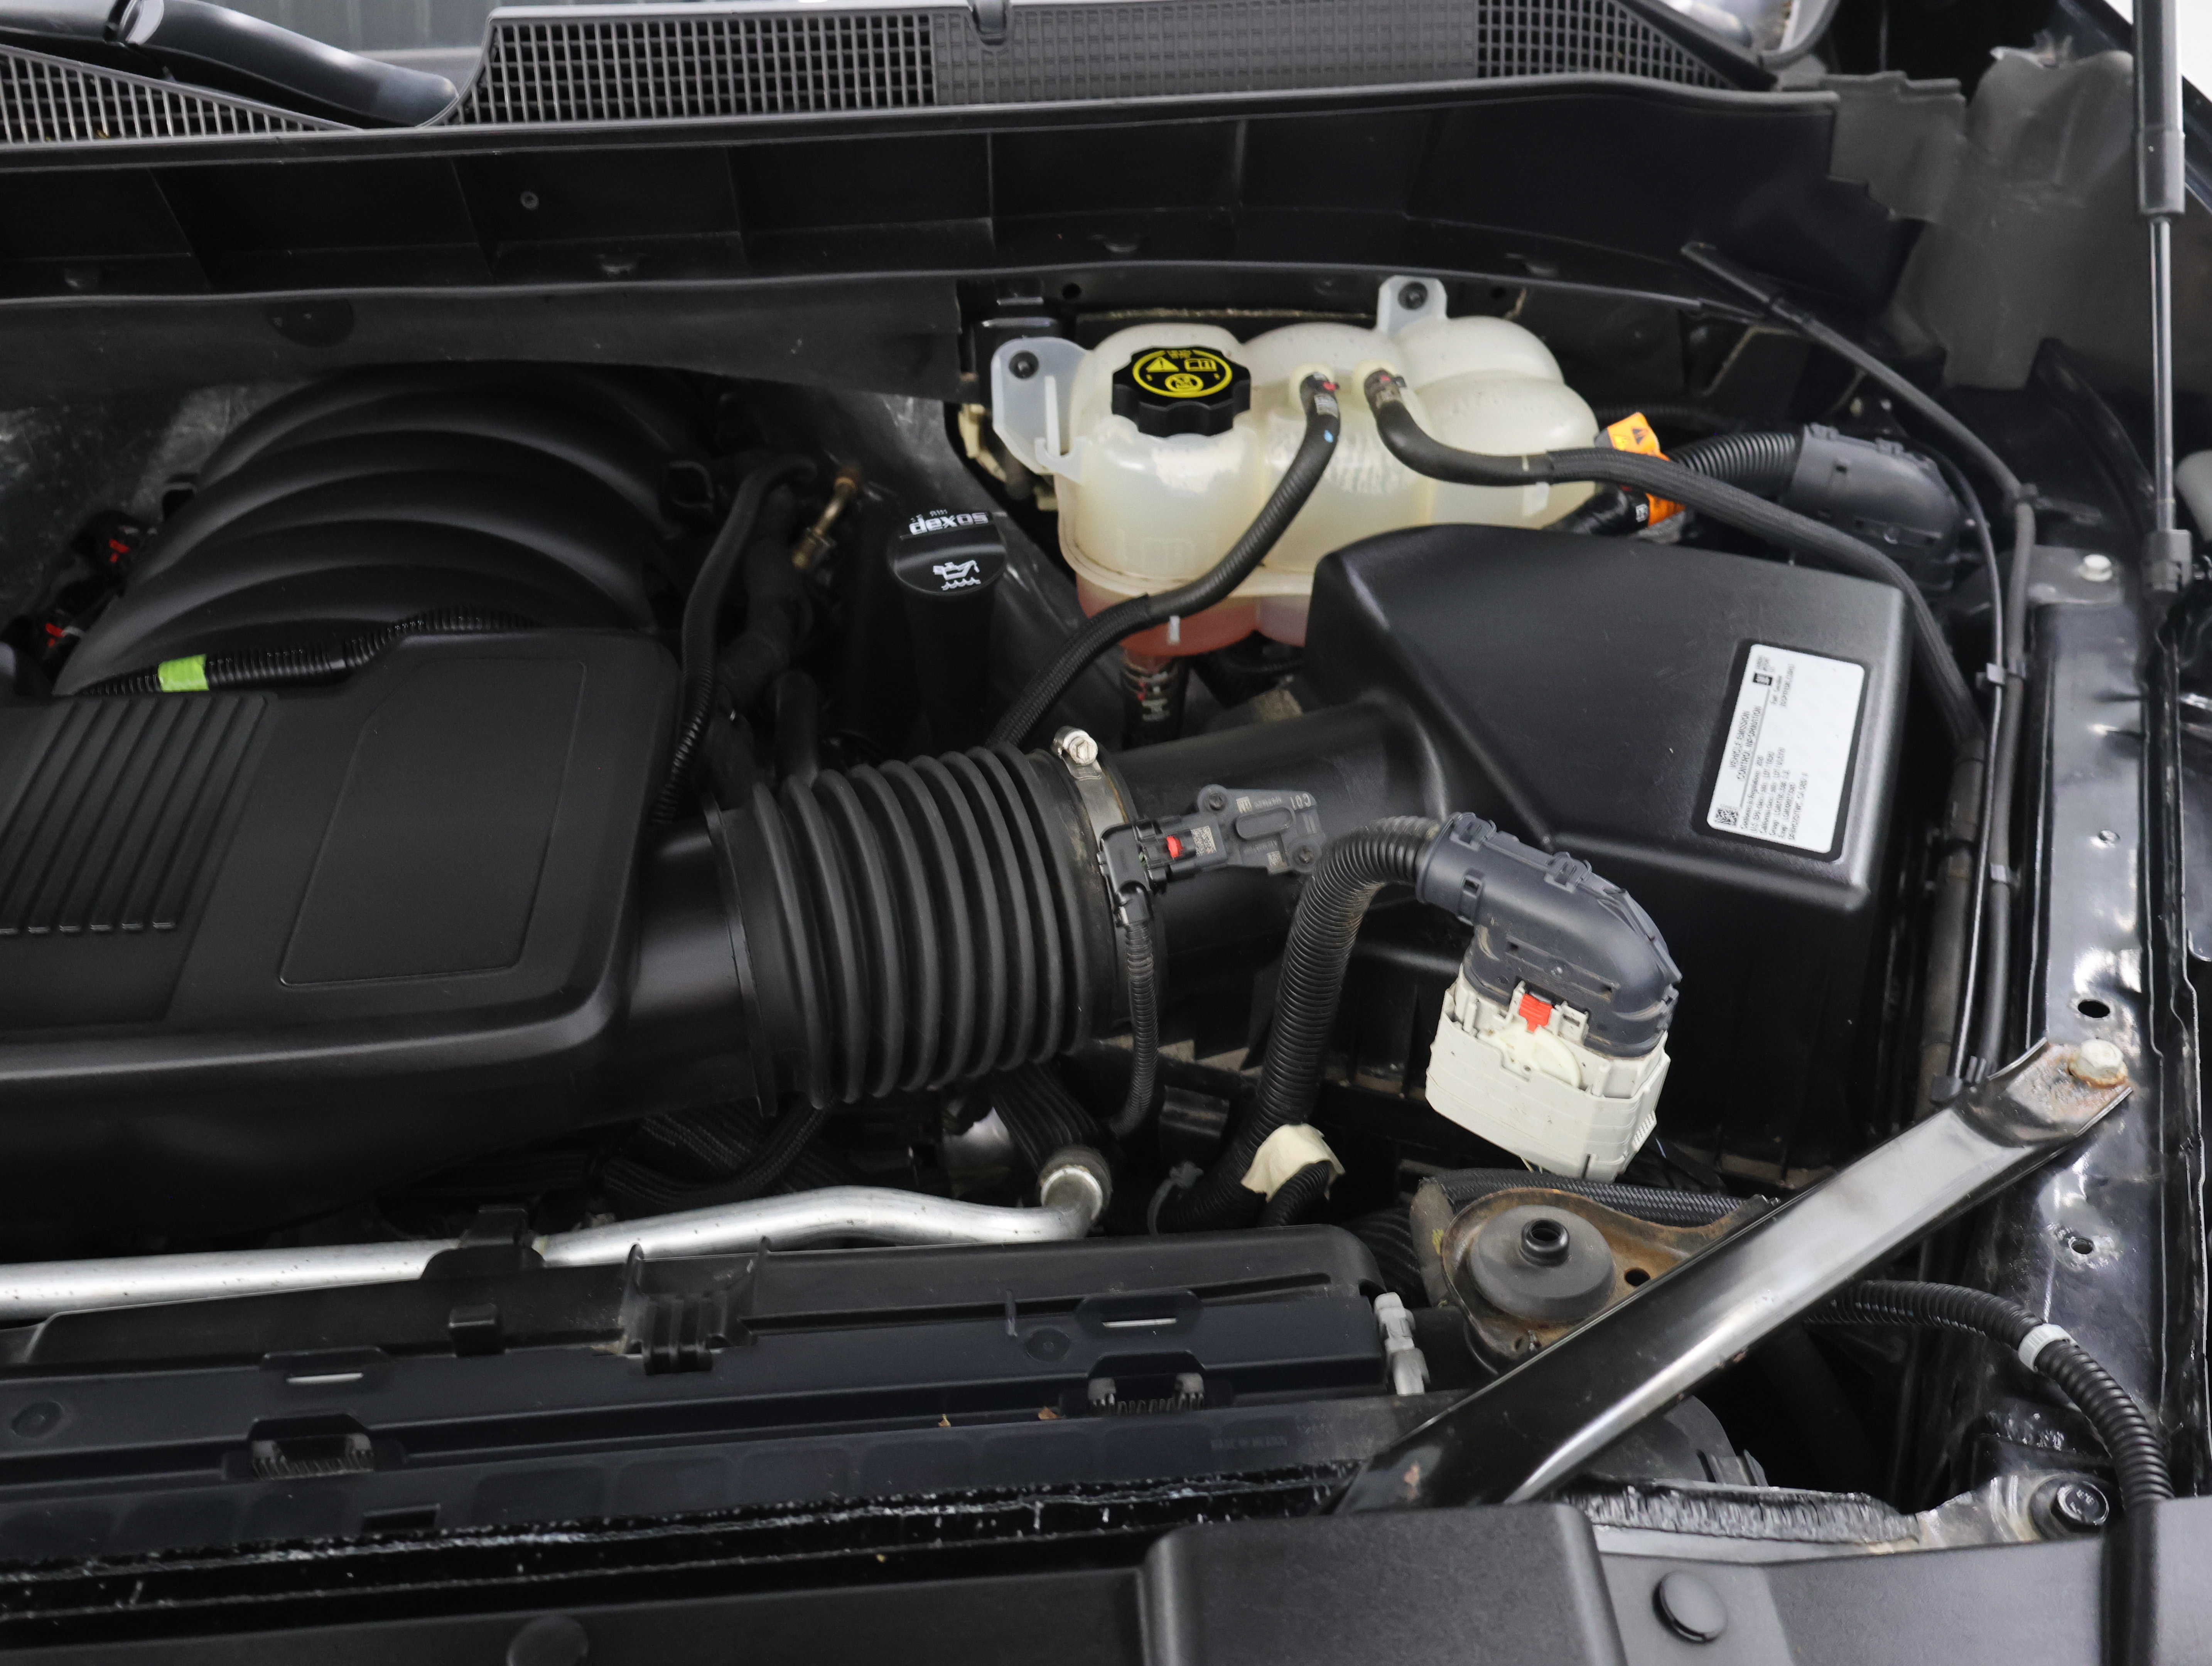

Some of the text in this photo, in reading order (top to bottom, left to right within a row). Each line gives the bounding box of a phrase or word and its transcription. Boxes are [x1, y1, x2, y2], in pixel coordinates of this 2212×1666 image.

[909, 512, 989, 535] dexos
[1728, 710, 1750, 769] VEHICLE EMISSION
[1736, 705, 1762, 781] CONTROL INFORMATION
